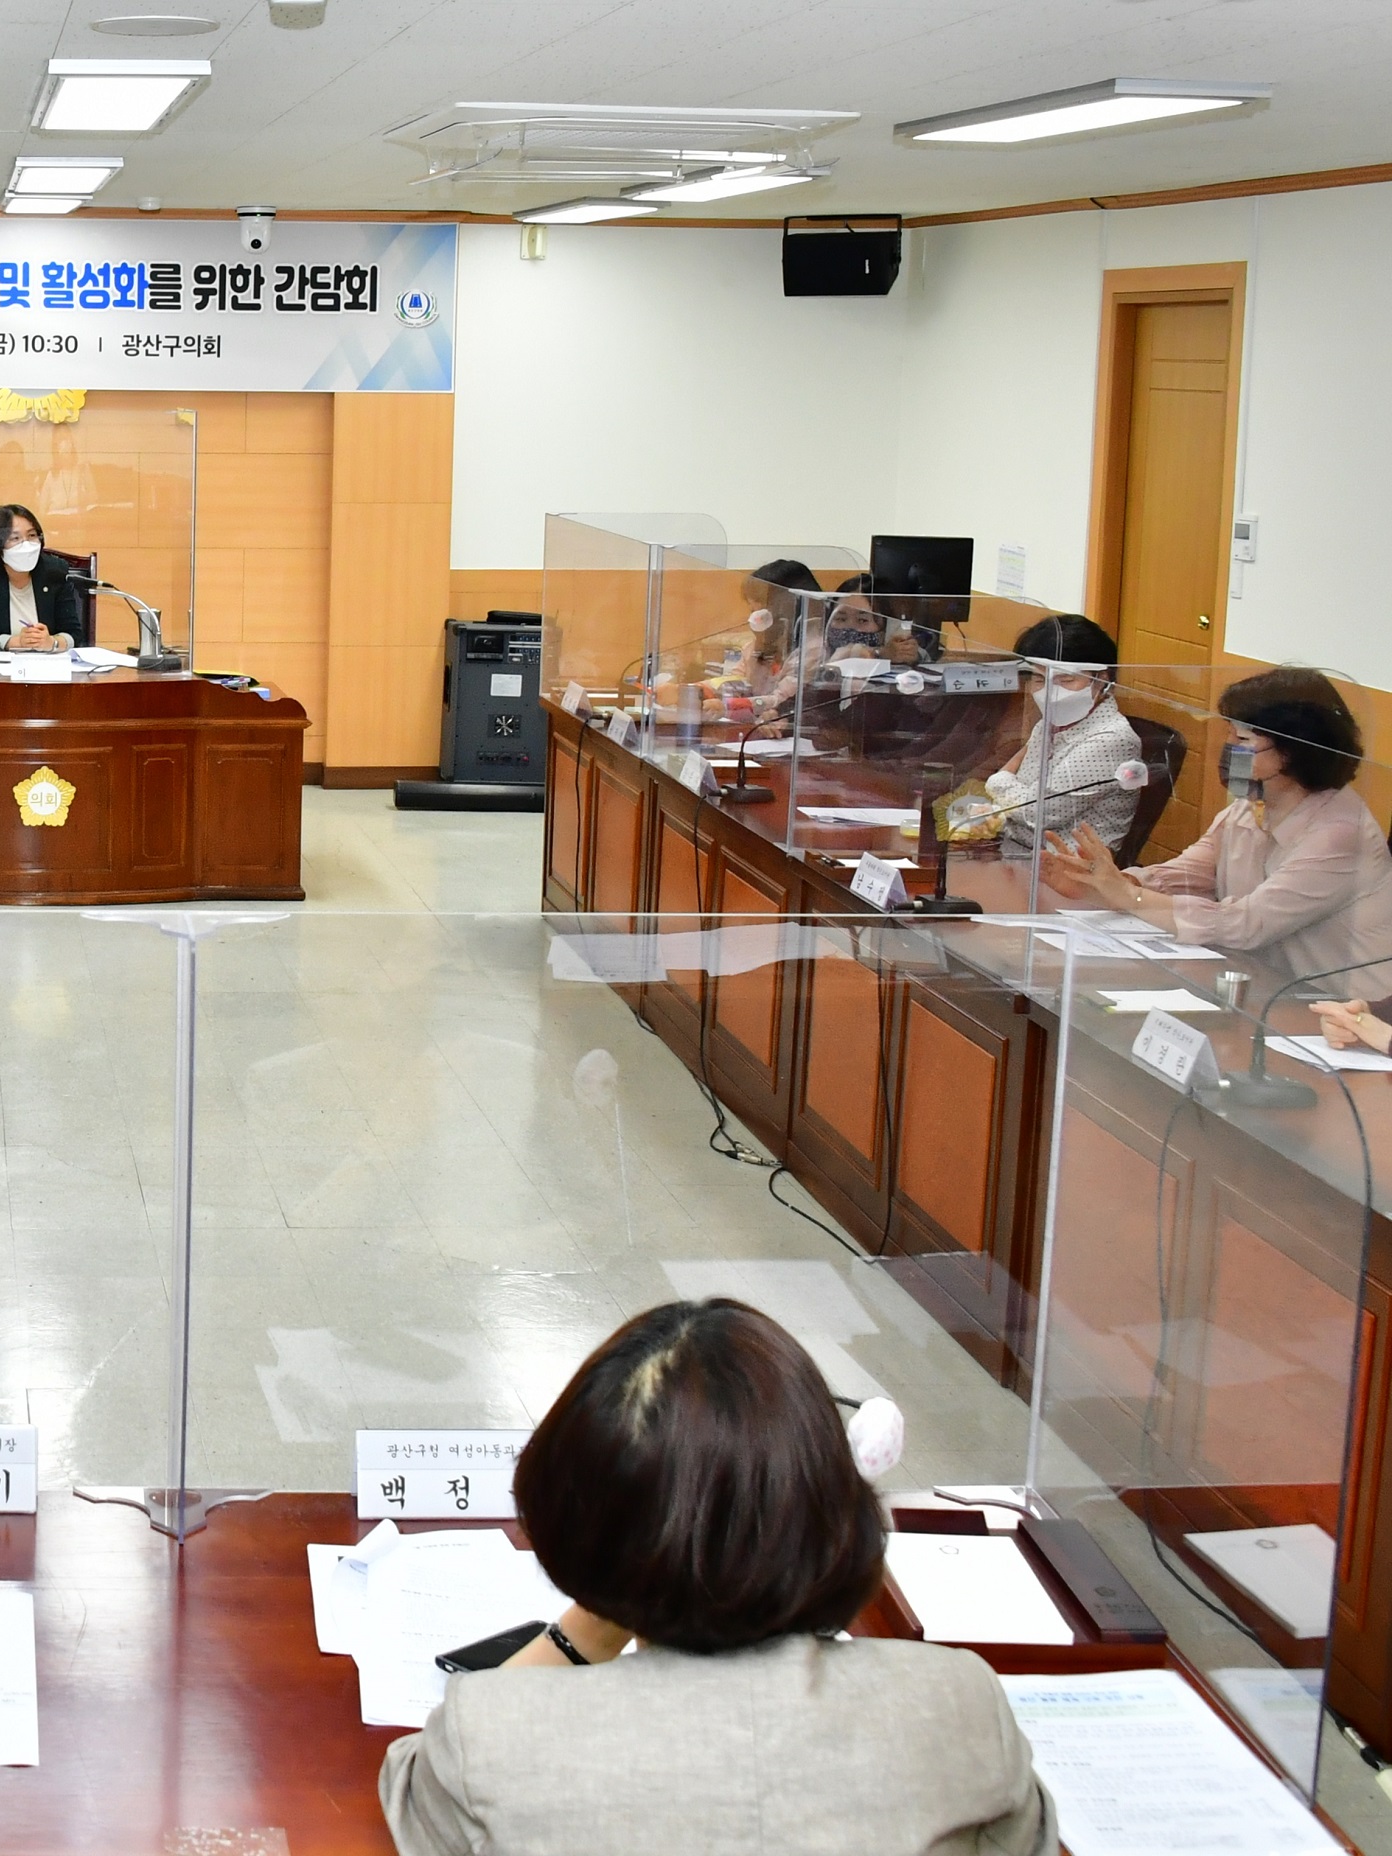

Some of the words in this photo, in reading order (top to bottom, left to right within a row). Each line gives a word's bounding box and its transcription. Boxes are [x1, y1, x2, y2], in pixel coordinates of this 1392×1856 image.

[42, 261, 183, 310] 활성화를
[193, 263, 266, 312] 위한
[274, 264, 378, 313] 간담회
[22, 334, 78, 354] 10:30
[122, 334, 222, 358] 광산구의회
[30, 791, 58, 807] 의회
[386, 1444, 439, 1459] 광산구청
[380, 1475, 406, 1510] 백
[444, 1475, 471, 1510] 정
